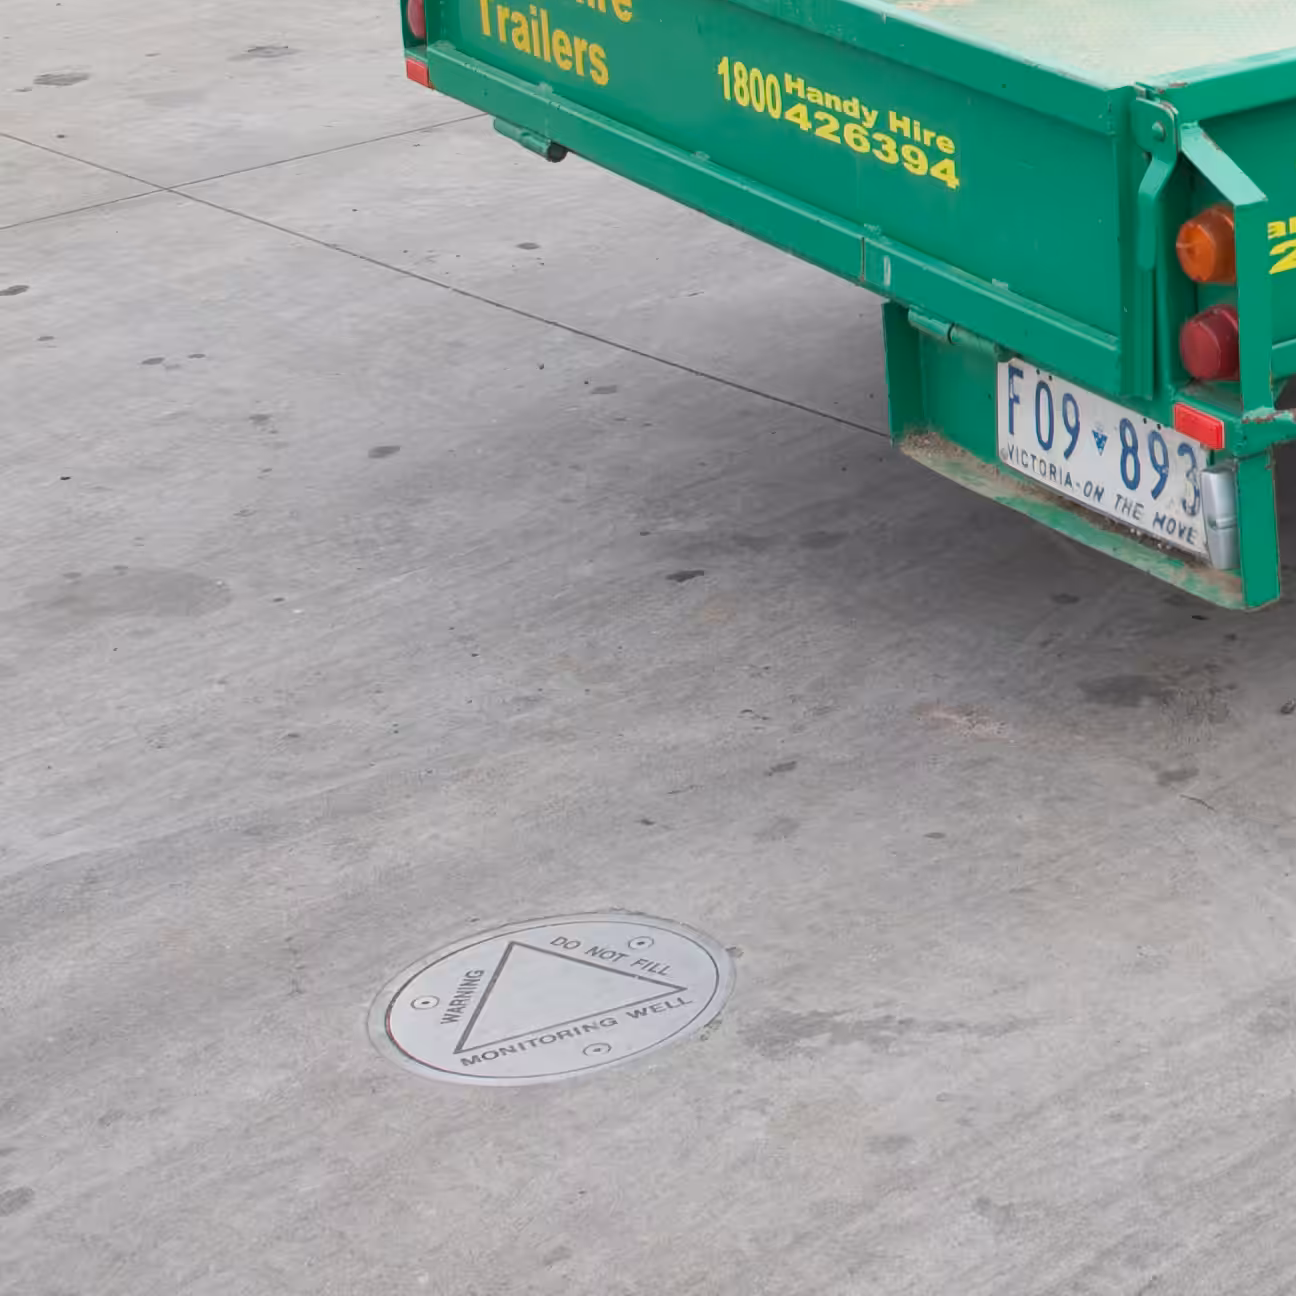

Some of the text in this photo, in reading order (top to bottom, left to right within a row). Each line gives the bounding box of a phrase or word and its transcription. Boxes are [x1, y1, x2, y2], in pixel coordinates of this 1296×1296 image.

[718, 56, 956, 154] 1800 Handy Hire
[784, 102, 960, 189] 426394
[1008, 364, 1081, 461] F09
[1115, 493, 1145, 521] THE
[1152, 512, 1198, 545] MOVE
[550, 936, 672, 976] DO NOT FILL
[441, 969, 485, 1025] WARNING
[460, 996, 693, 1066] MONITORING WELL
